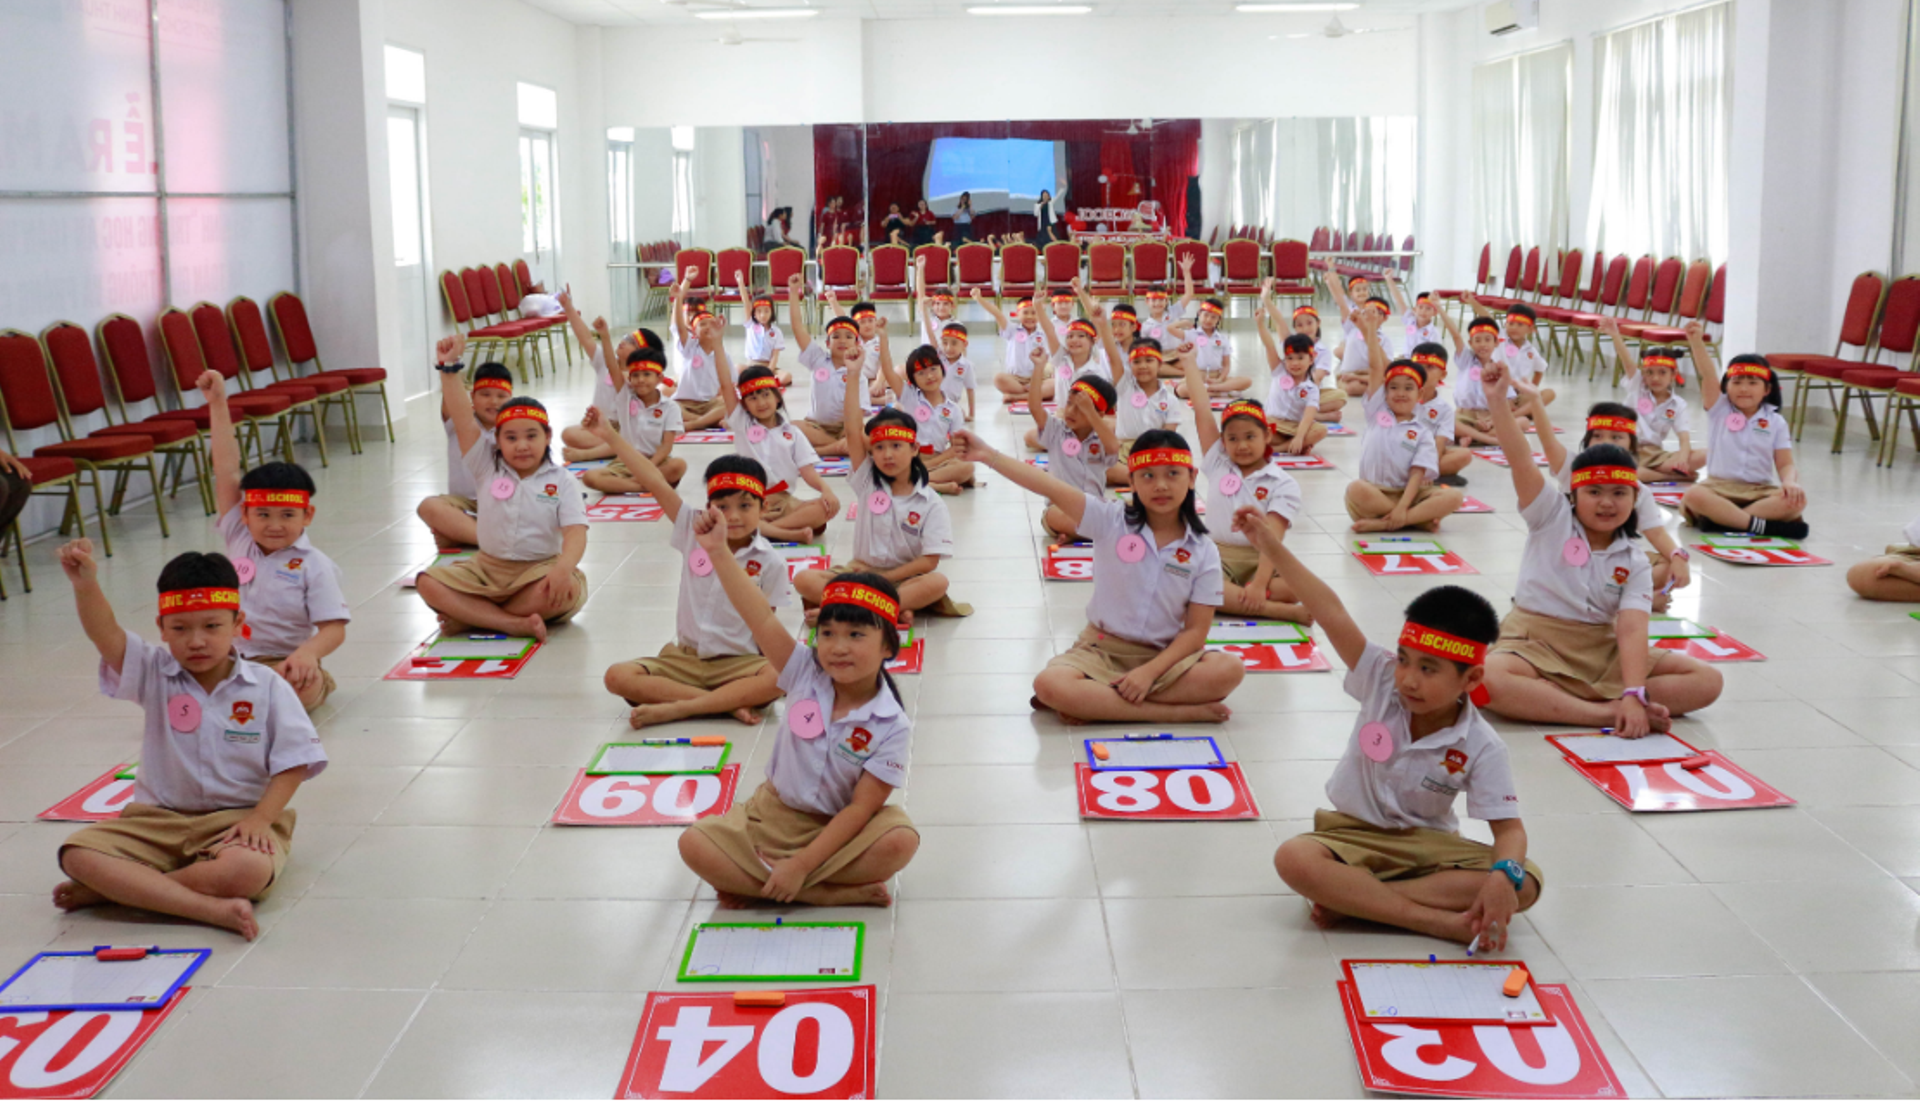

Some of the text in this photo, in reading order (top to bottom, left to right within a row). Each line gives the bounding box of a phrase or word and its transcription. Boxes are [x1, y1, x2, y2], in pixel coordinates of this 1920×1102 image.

[1134, 454, 1152, 466] LOVE
[588, 505, 652, 520] 25
[1382, 554, 1460, 572] 17
[851, 588, 896, 617] iSCHOOL
[1420, 633, 1475, 659] iSCHOOL
[180, 704, 189, 717] 5
[803, 712, 815, 724] 4
[1372, 732, 1383, 747] 3
[579, 774, 722, 818] 09
[1090, 769, 1236, 812] 08
[656, 1002, 855, 1094] 04
[1371, 1012, 1582, 1085] 03
